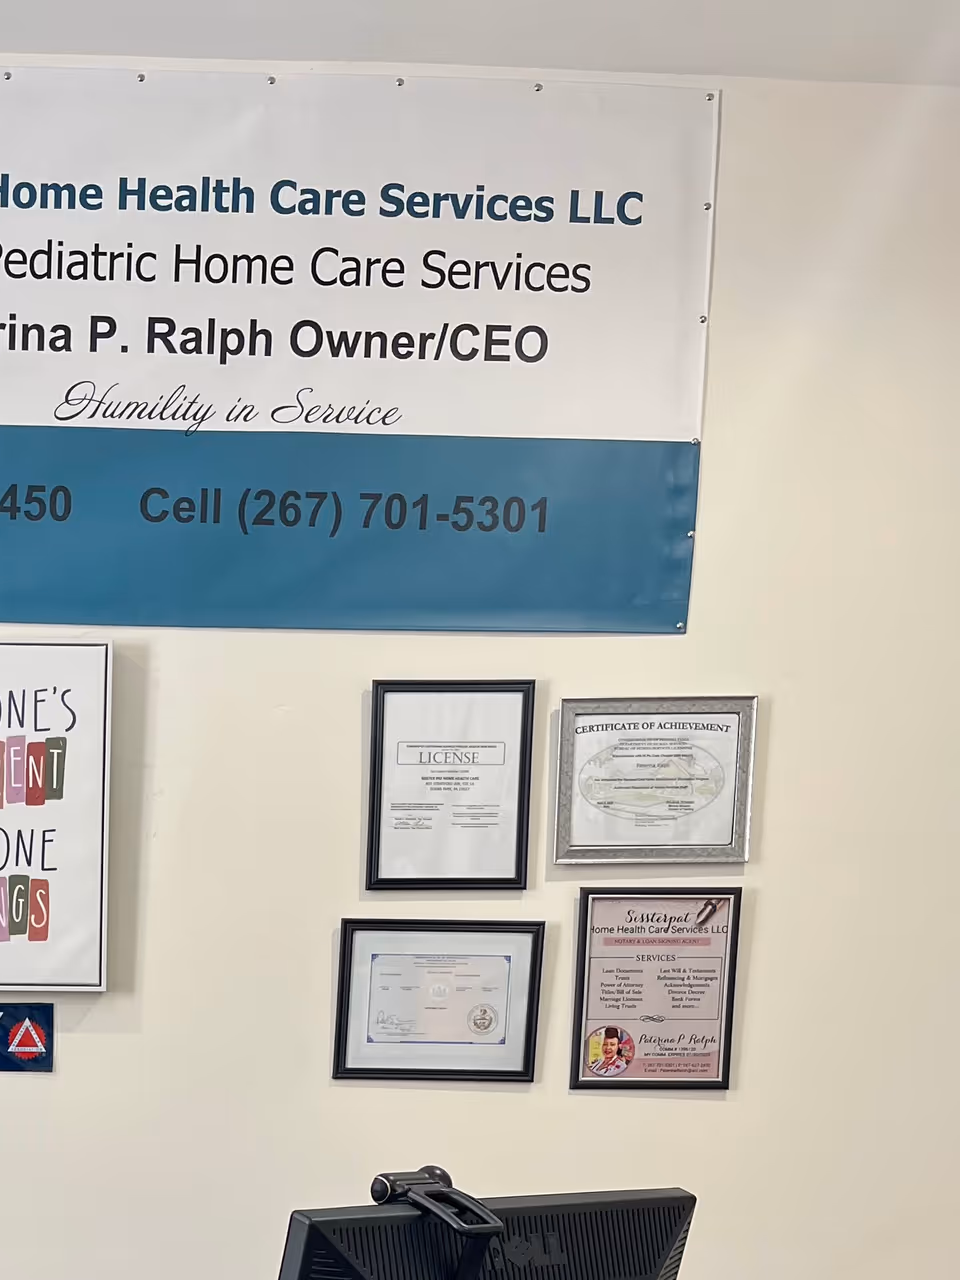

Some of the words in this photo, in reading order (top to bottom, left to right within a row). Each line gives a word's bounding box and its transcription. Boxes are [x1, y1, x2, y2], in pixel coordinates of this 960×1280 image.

[117, 176, 254, 214] Health
[270, 179, 366, 217] Care
[379, 182, 554, 224] Services
[569, 189, 643, 226] LLC
[173, 244, 294, 285] Home
[310, 246, 405, 289] Care
[421, 249, 591, 293] Services
[89, 316, 129, 355] P.
[146, 316, 273, 365] Ralph
[290, 320, 548, 363] Owner/CEO
[54, 380, 216, 437] Humility
[226, 397, 259, 425] in
[270, 388, 403, 428] Service
[140, 486, 220, 525] Cell
[237, 490, 342, 537] (267)
[359, 495, 548, 533] 701-5301
[575, 722, 639, 735] CERTIFICATE
[642, 722, 655, 730] OF
[657, 722, 731, 733] ACHIEVEMENT
[419, 752, 479, 763] LICENSE
[625, 910, 692, 932] Sissterpat
[671, 926, 708, 934] Services
[688, 1034, 717, 1050] Ralph
